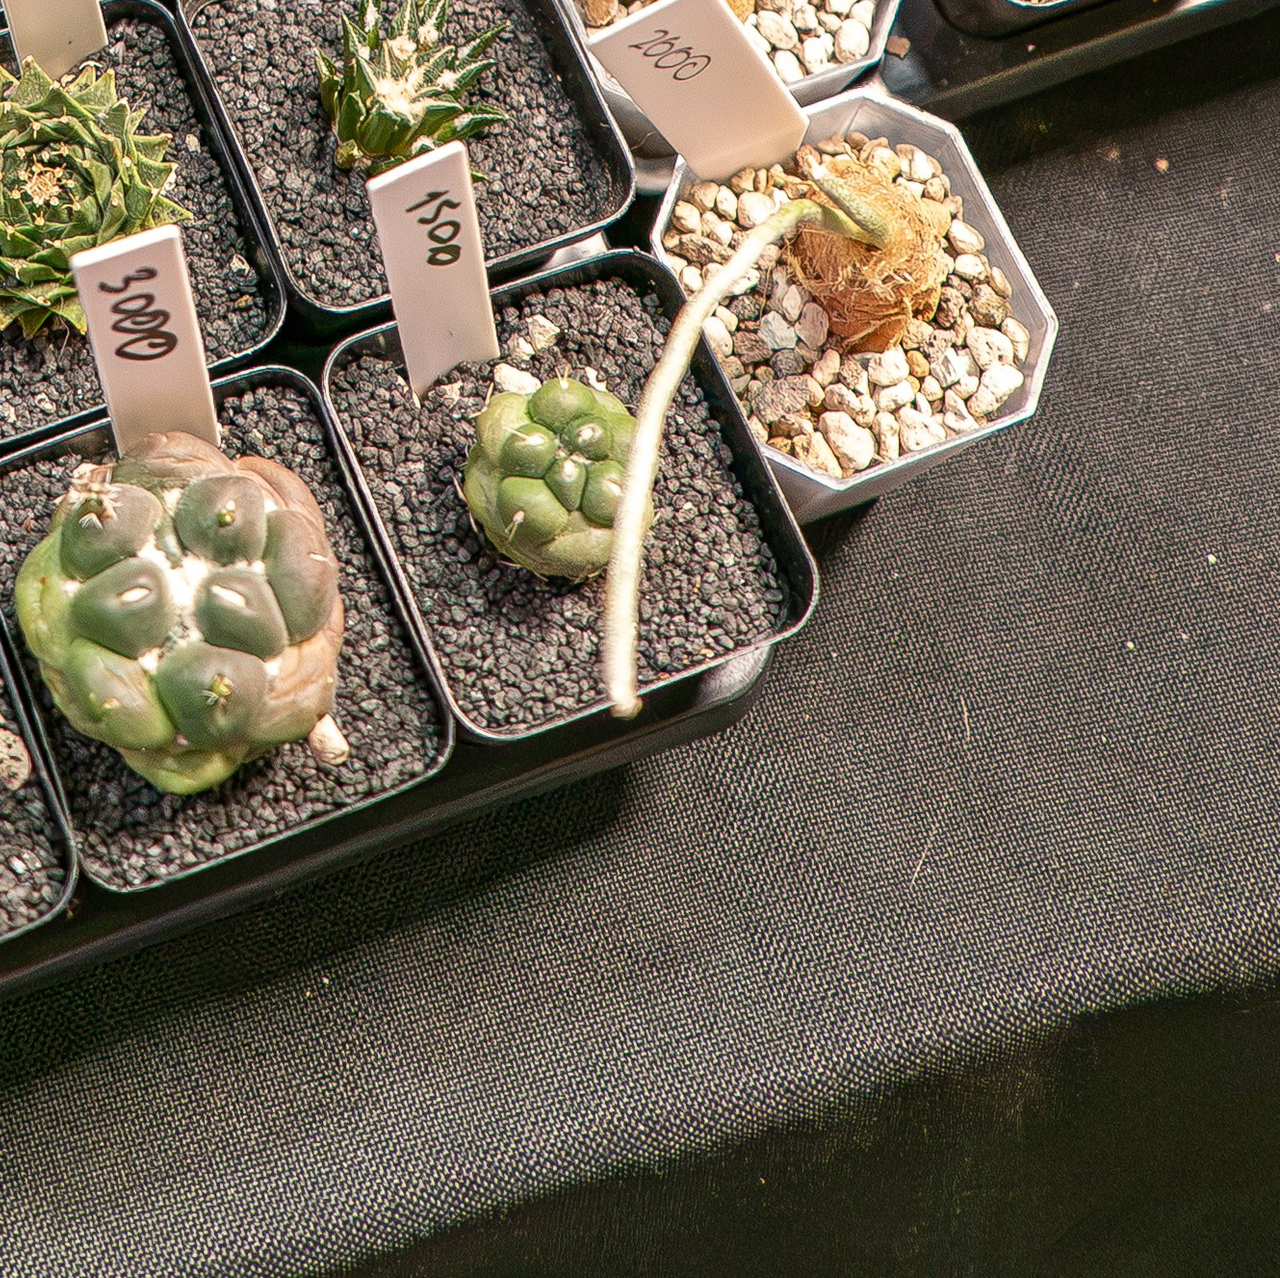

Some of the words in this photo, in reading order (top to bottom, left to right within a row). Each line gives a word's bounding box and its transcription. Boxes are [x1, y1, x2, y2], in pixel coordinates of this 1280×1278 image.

[628, 29, 711, 81] 2000
[405, 189, 462, 266] 1500
[97, 265, 179, 361] 3000
